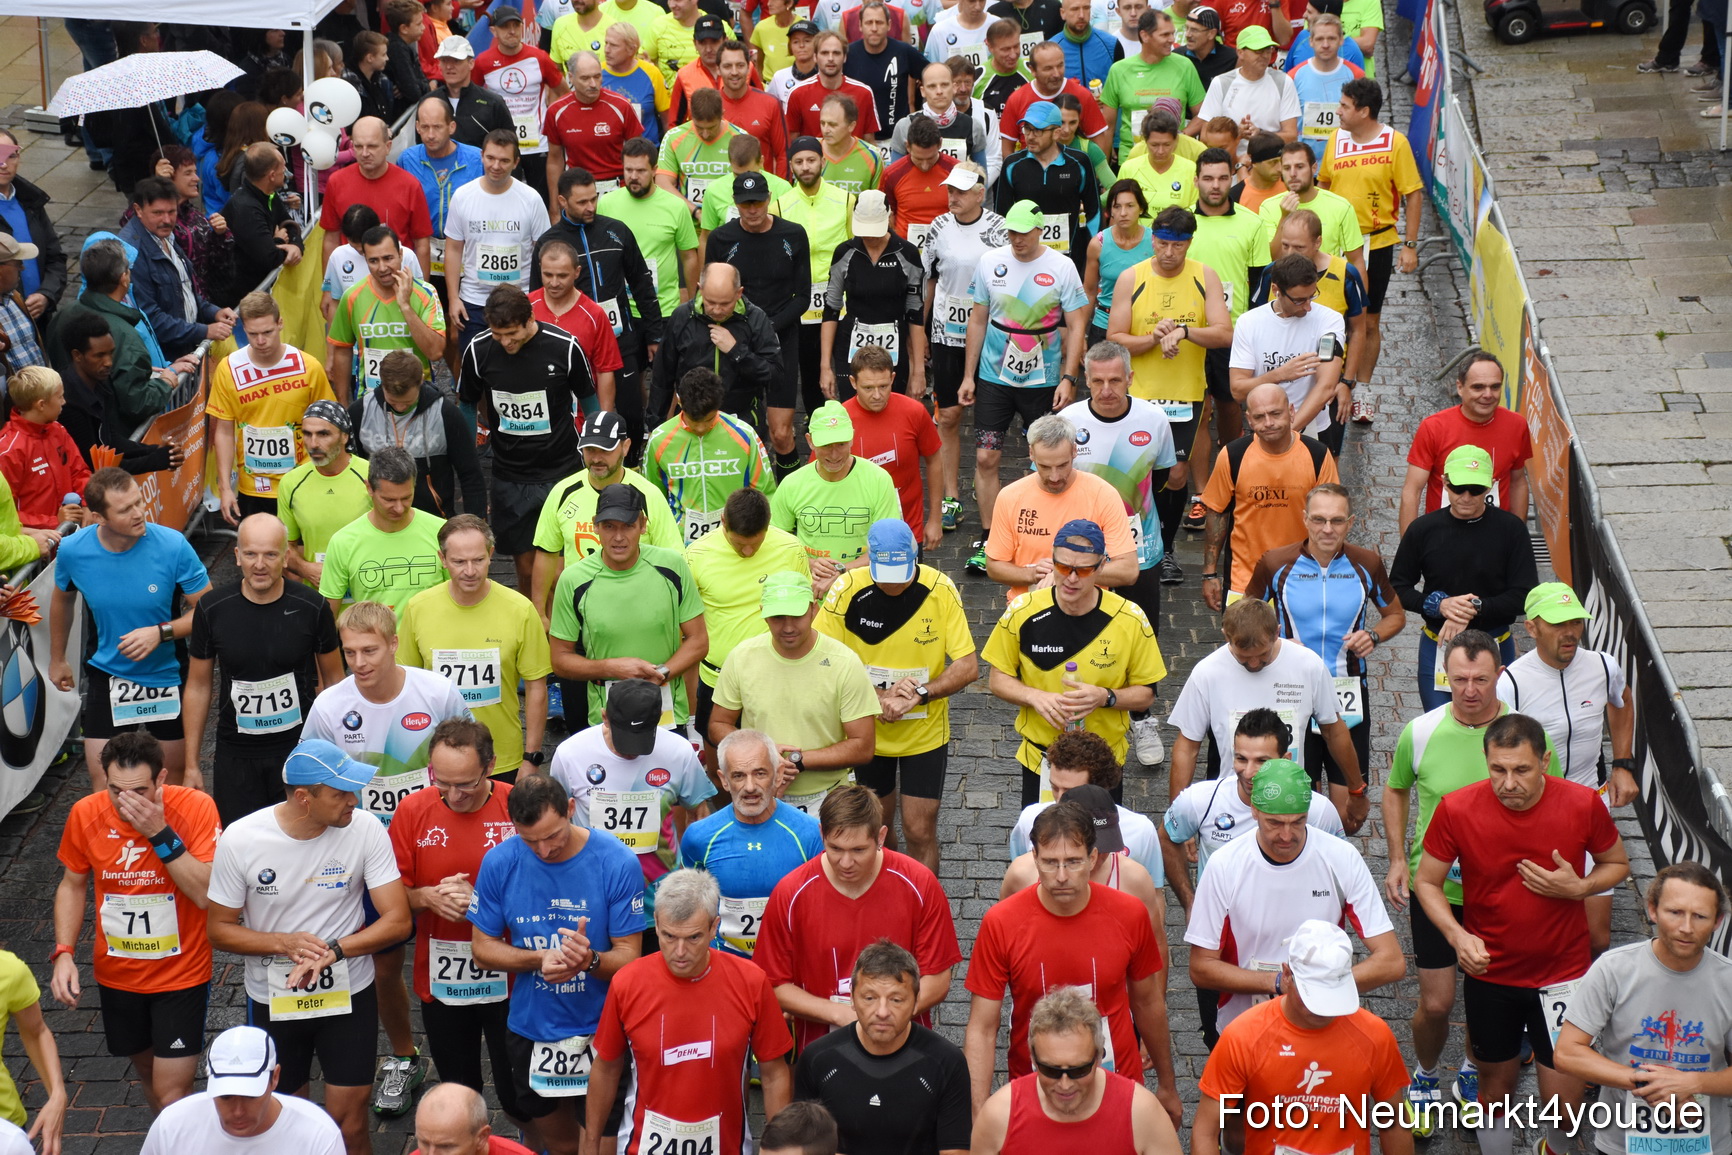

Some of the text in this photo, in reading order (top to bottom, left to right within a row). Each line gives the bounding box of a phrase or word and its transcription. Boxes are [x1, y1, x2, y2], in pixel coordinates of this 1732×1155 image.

[1316, 111, 1334, 126] 49
[1333, 154, 1392, 172] MAX BÖGL
[487, 221, 521, 231] NXTGN
[481, 254, 518, 271] 2865
[856, 333, 895, 350] 2812
[1007, 354, 1039, 374] 2451
[239, 378, 309, 405] MAX BÖGL
[499, 402, 544, 420] 2854
[509, 422, 535, 431] Philipp
[247, 437, 290, 456] 2708
[254, 459, 282, 468] Thomas
[667, 458, 741, 479] BOCK
[1254, 489, 1290, 501] OEXL
[1018, 517, 1035, 527] DIG
[859, 616, 884, 629] Peter
[1031, 644, 1064, 653] Markus
[462, 651, 493, 660] BOCK
[440, 663, 495, 686] 2714
[256, 677, 289, 691] BOCK
[237, 688, 293, 714] 2713
[136, 705, 157, 715] Gerd
[254, 716, 283, 727] Marco
[388, 773, 423, 786] BOCK
[622, 793, 655, 803] BOCK
[604, 806, 648, 831] 347
[1211, 830, 1233, 840] PARTL
[416, 838, 437, 848] Spitz
[102, 869, 156, 880] funrunners
[118, 876, 165, 887] neumarkt
[1312, 890, 1330, 898] Martin
[129, 895, 167, 907] BOCK
[121, 910, 152, 936] 71
[121, 940, 160, 951] Michael
[446, 985, 491, 996] Bernhard
[561, 982, 575, 993] did
[577, 981, 586, 992] it
[296, 997, 324, 1010] Peter
[677, 1048, 698, 1058] DEHN
[1643, 1050, 1701, 1063] FINISHER
[675, 1121, 714, 1134] BOCK
[647, 1131, 714, 1155] 2404
